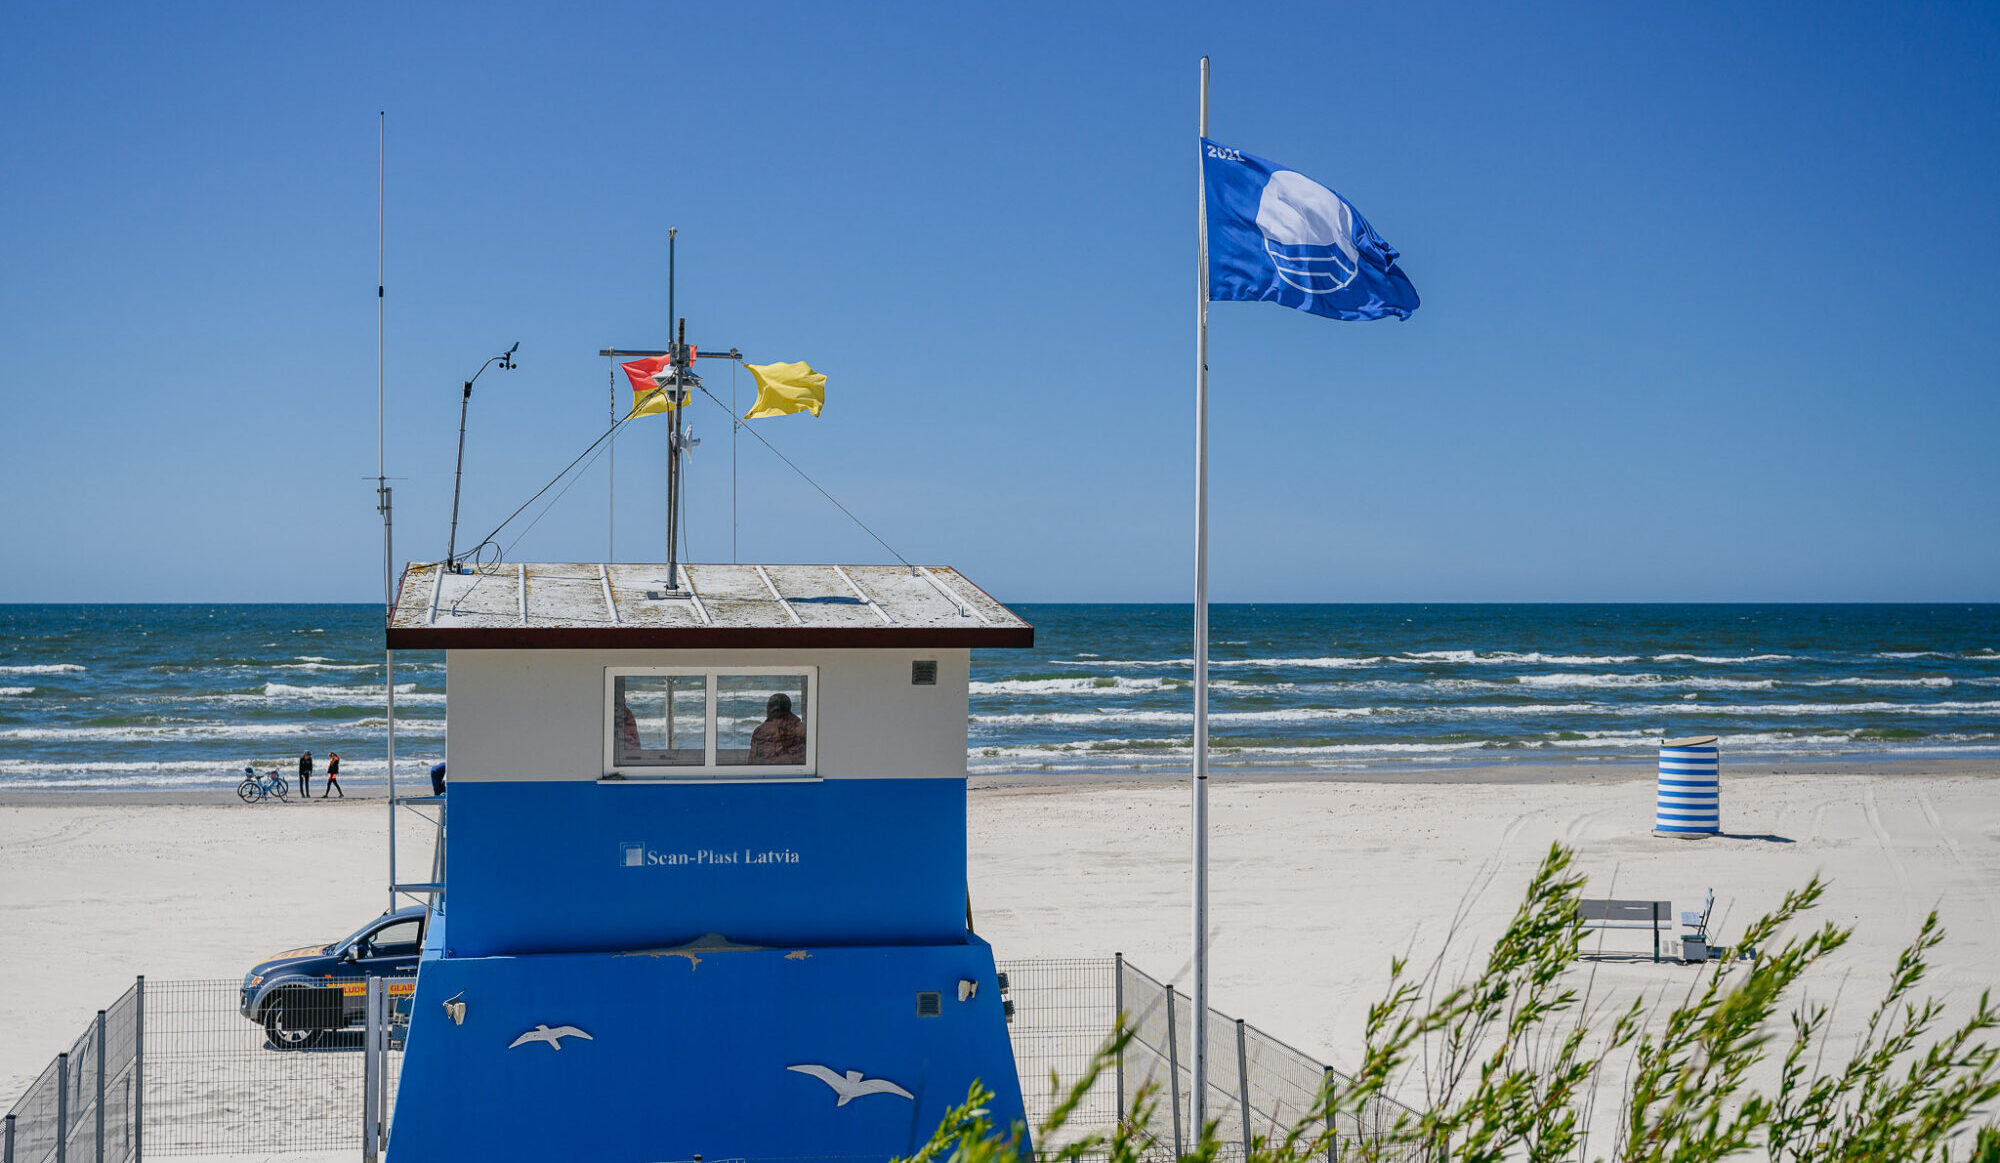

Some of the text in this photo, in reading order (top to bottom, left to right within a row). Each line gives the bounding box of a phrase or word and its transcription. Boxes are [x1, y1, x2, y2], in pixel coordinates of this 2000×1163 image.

[1207, 144, 1245, 162] 2021
[647, 848, 800, 865] Scan-Plast Latvia
